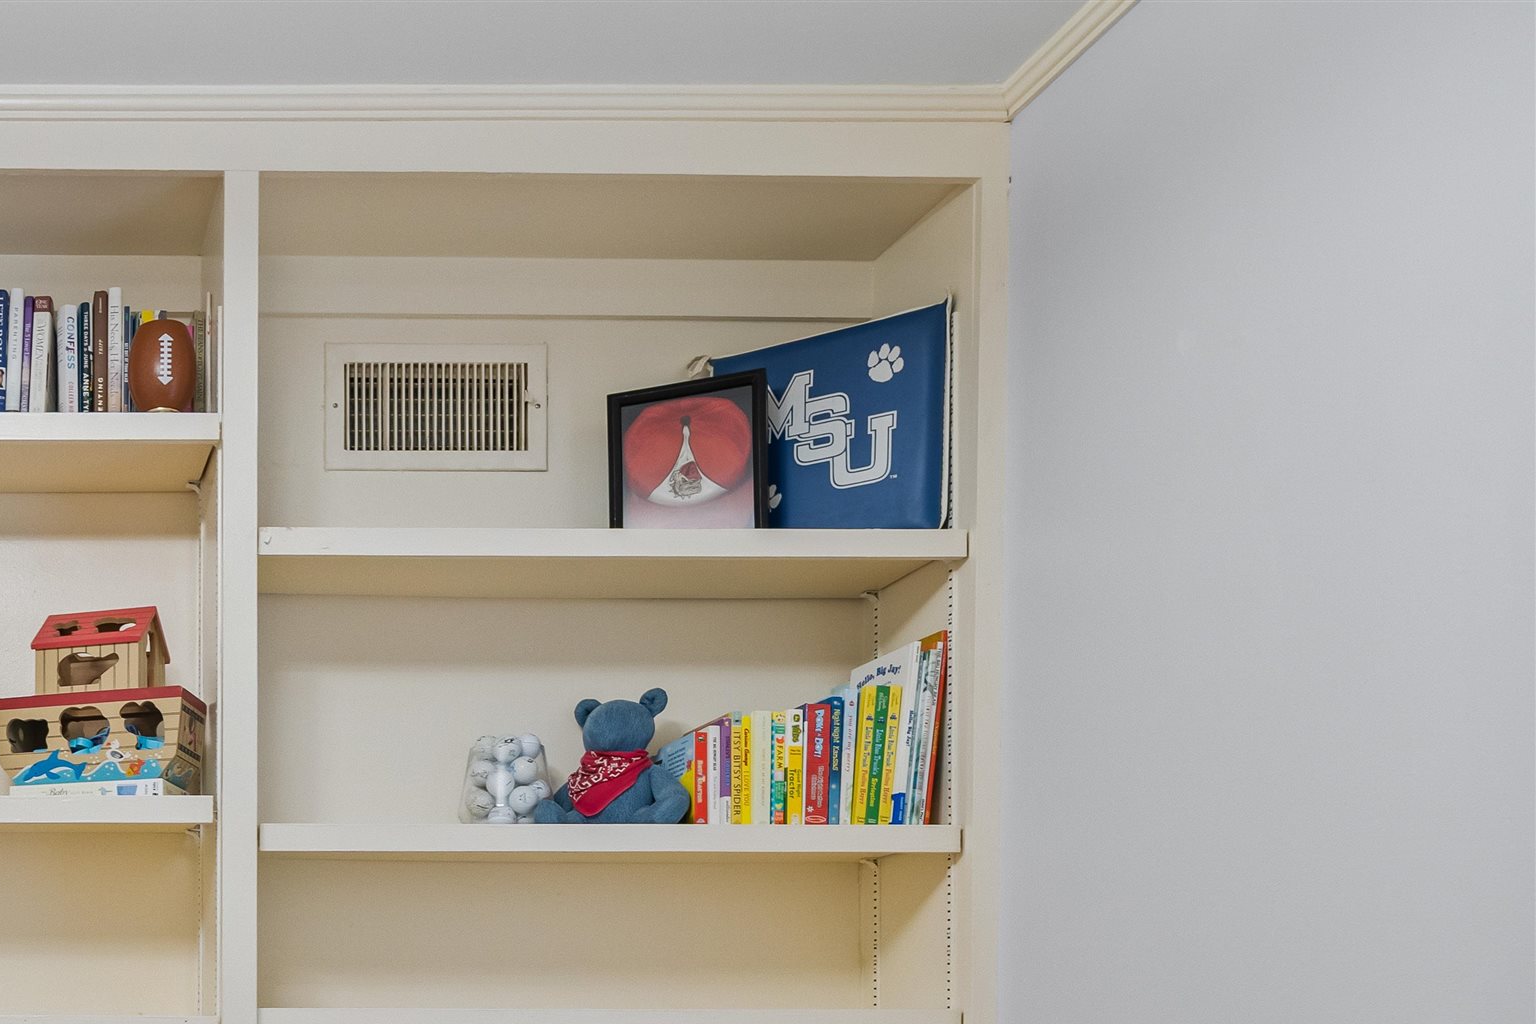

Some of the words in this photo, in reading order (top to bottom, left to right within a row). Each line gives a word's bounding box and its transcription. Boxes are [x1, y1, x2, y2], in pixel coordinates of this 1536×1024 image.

[110, 305, 119, 320] His
[35, 324, 45, 361] WOMEN
[66, 316, 75, 369] CONFESS
[109, 323, 119, 351] Needs,
[110, 353, 119, 369] Her
[82, 373, 90, 396] ANNE
[110, 371, 119, 396] Needs
[767, 369, 898, 490] MSU
[876, 665, 887, 676] Big
[887, 664, 902, 676] Jay!
[833, 708, 841, 725] Night
[833, 727, 841, 743] Night
[875, 729, 883, 742] Little
[888, 725, 896, 738] Little
[862, 752, 870, 767] Truck
[885, 751, 893, 766] Truck
